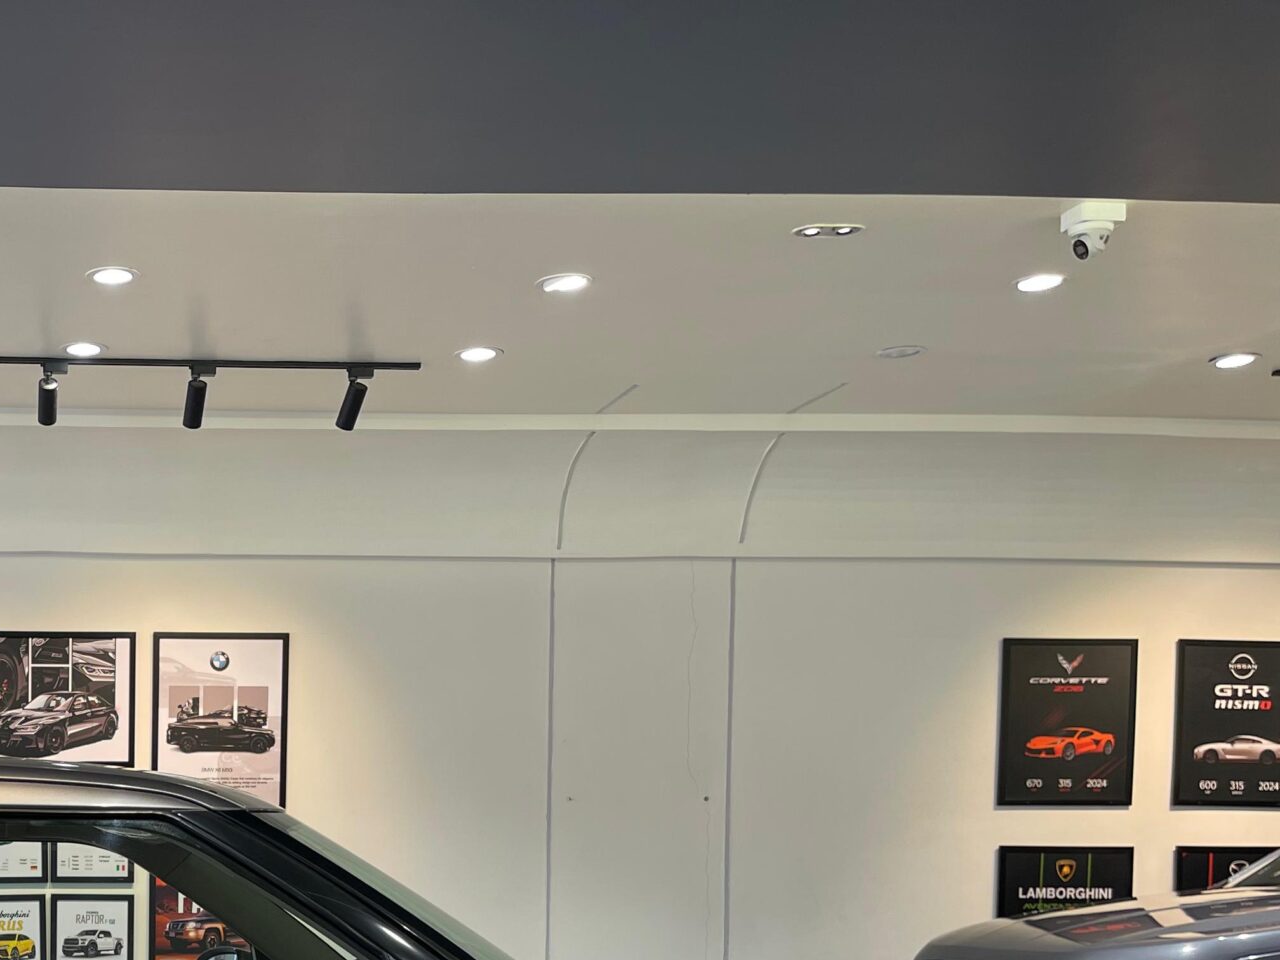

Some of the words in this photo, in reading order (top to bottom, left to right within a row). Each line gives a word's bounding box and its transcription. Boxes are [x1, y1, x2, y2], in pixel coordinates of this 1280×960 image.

[1214, 684, 1270, 698] GT-R
[1026, 778, 1043, 788] 670
[1058, 778, 1072, 788] 315
[1086, 778, 1107, 788] 2024
[1199, 780, 1217, 790] 600
[1229, 780, 1244, 790] 315
[1258, 781, 1279, 791] 2024
[1018, 887, 1113, 900] LAMBORGHINI
[75, 914, 105, 925] RAPTOR
